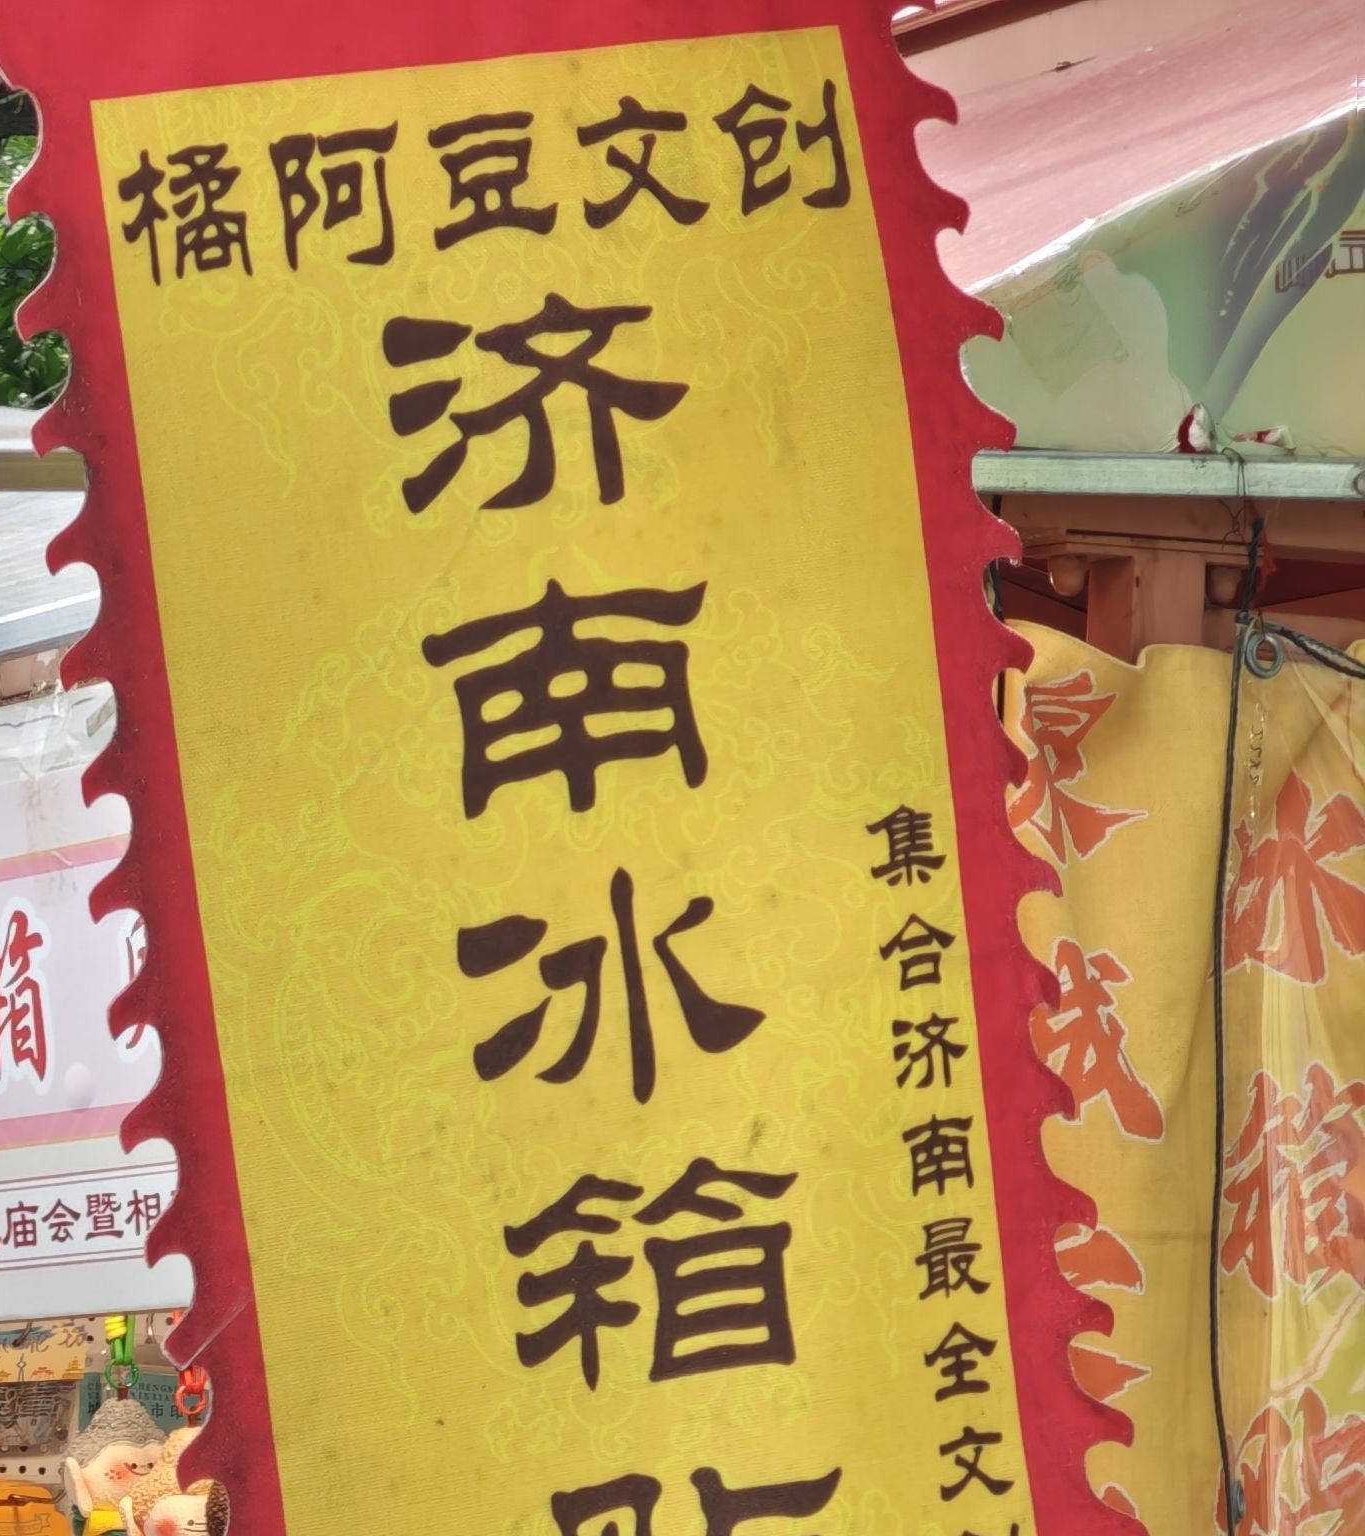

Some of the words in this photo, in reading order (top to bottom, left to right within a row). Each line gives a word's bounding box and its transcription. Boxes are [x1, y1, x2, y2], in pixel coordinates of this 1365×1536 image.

[121, 80, 853, 286] 橘阿豆文创
